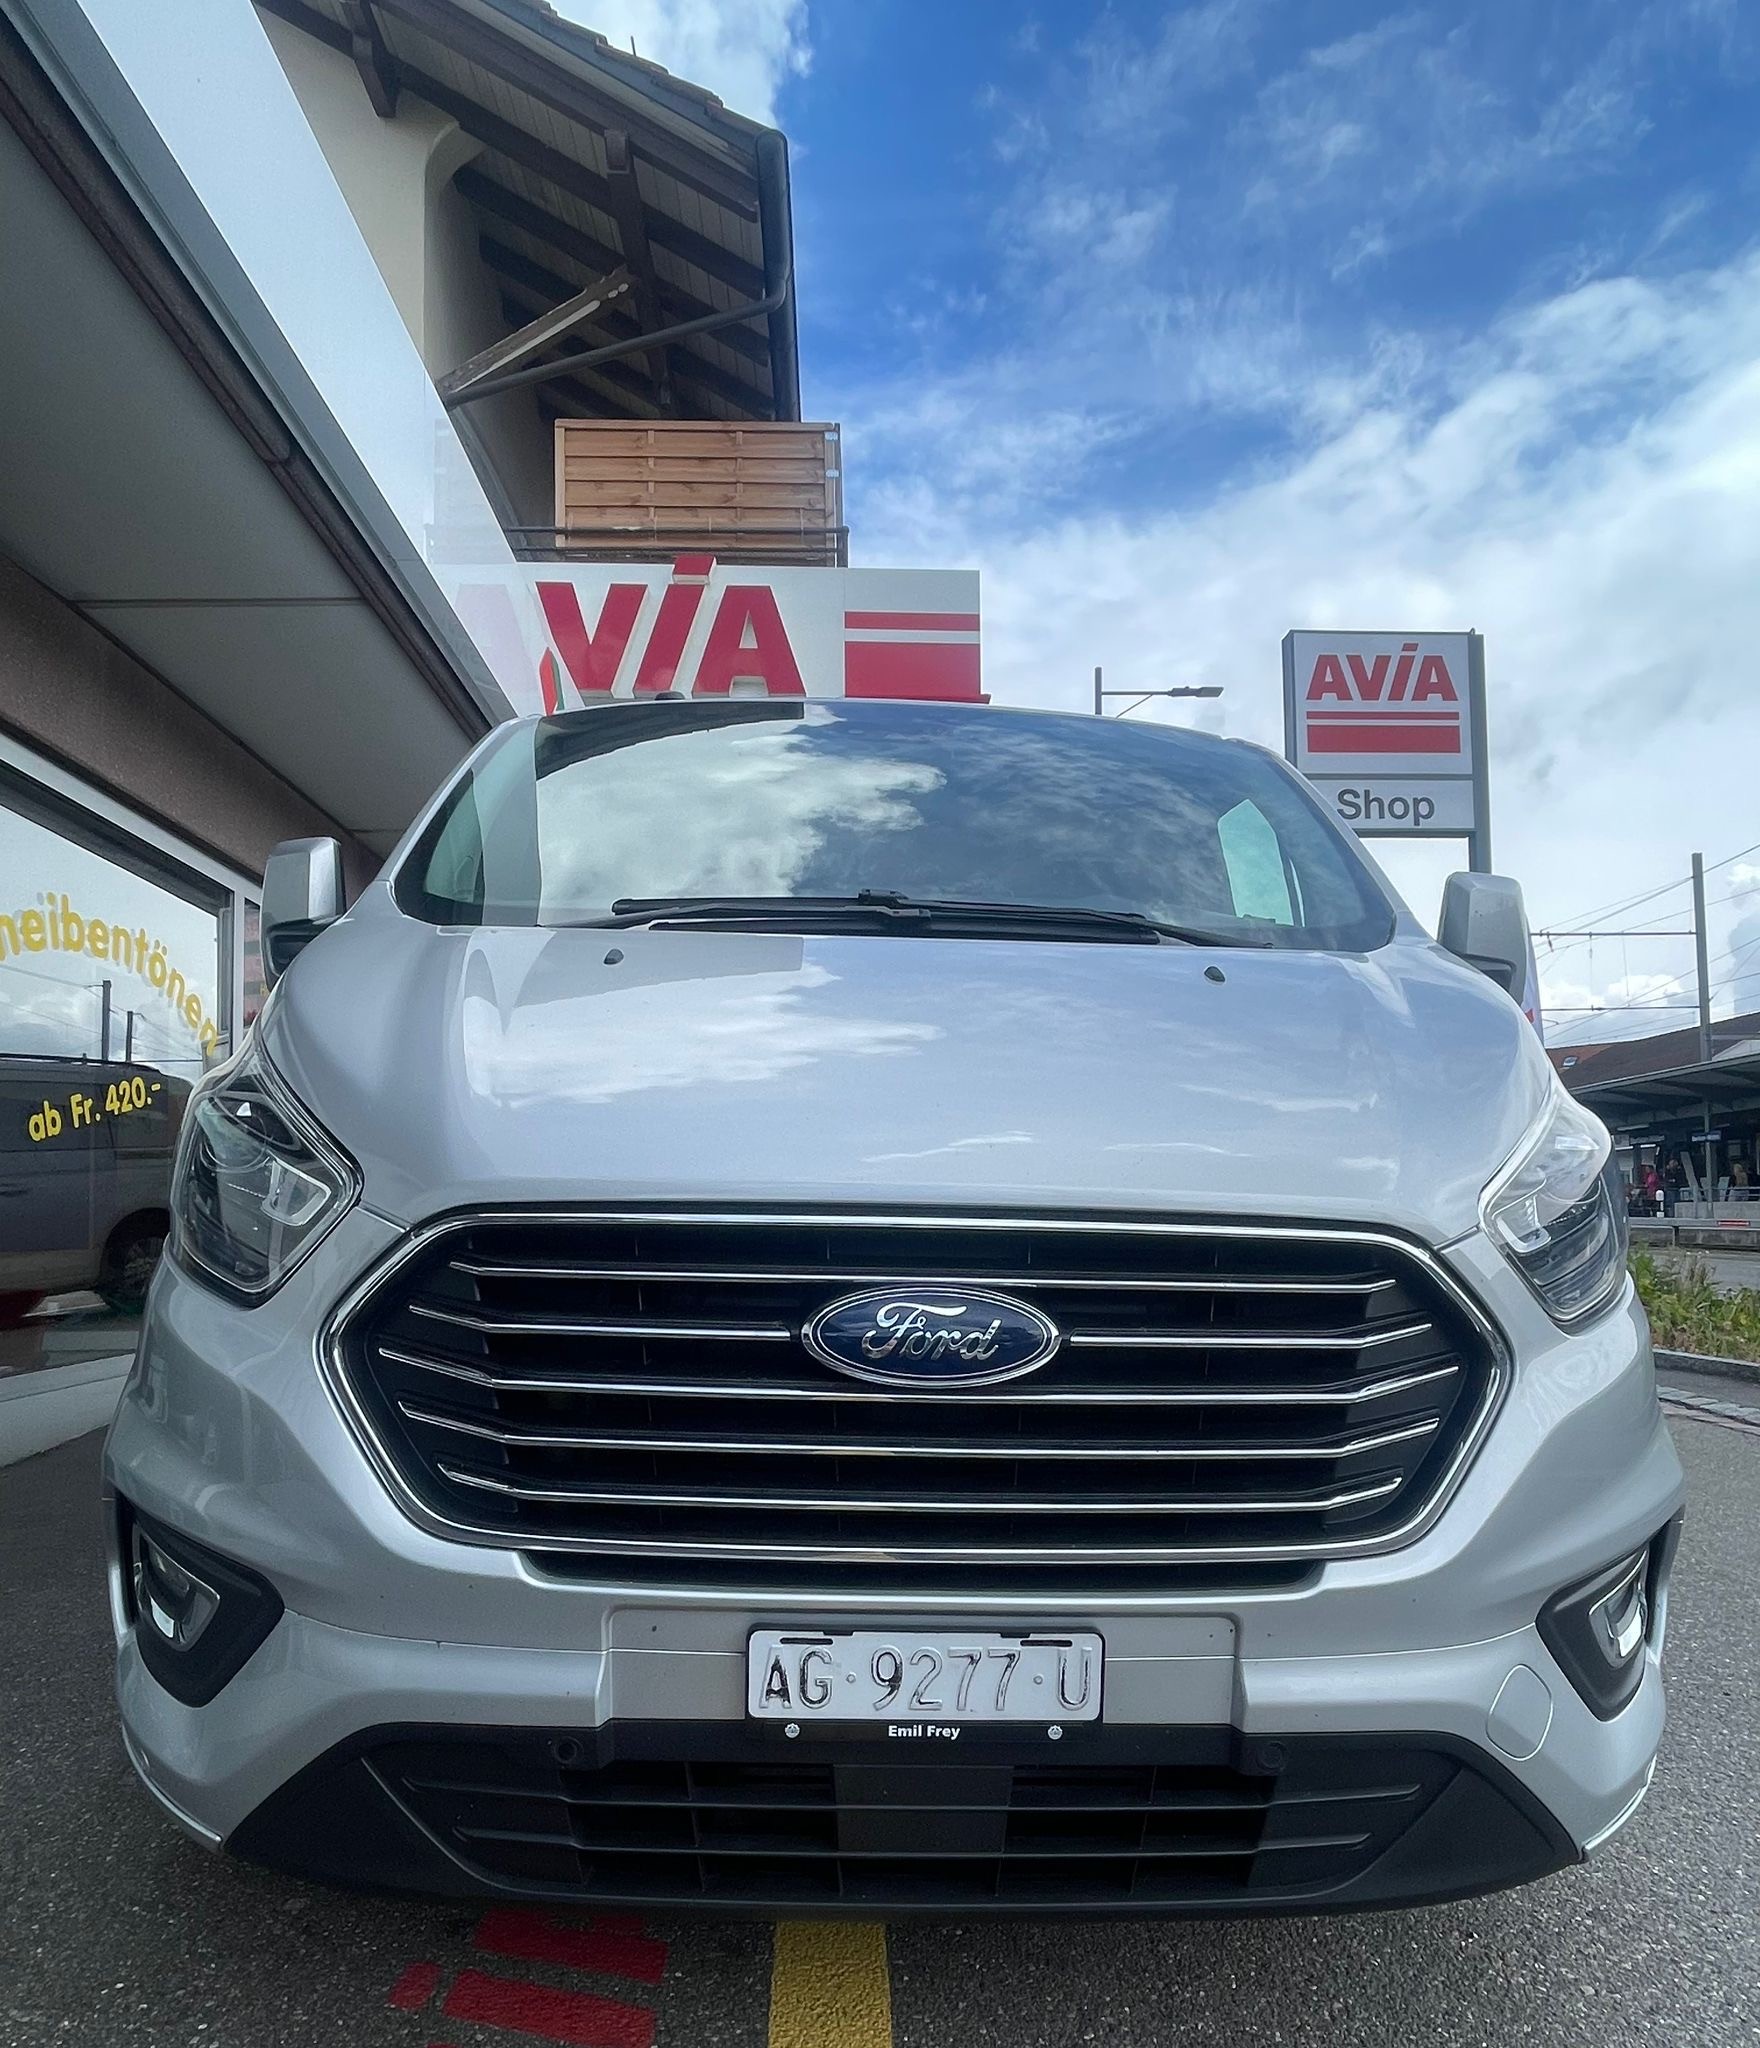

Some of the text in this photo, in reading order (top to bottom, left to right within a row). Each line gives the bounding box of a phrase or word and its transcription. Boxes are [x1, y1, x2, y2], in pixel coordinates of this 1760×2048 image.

[1306, 643, 1458, 701] AVIA
[1337, 788, 1435, 826] Shop
[28, 1077, 161, 1141] ab Fr. 420.-
[862, 1302, 1001, 1360] Ford
[888, 1724, 960, 1740] Emil Frey
